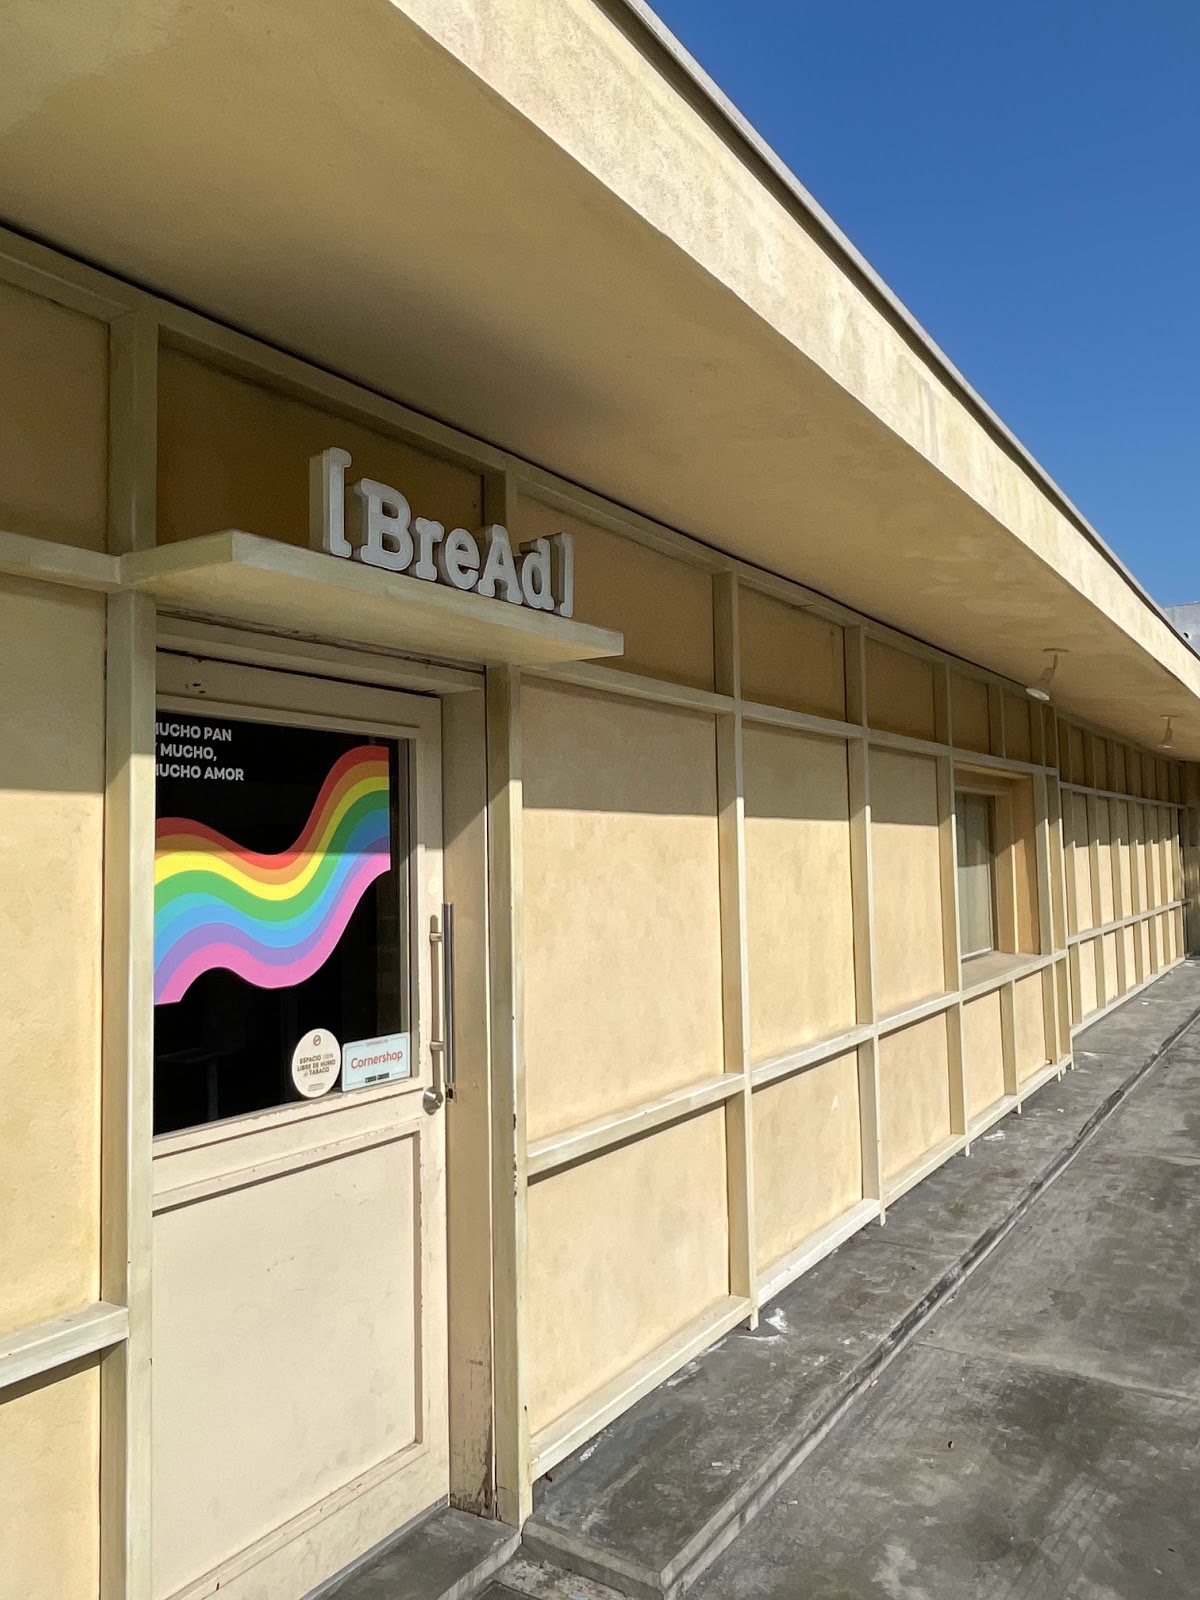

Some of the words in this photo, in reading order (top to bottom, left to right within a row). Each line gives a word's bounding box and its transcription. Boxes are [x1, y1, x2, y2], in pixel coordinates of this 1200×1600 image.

[203, 726, 232, 741] PAN
[160, 743, 217, 762] MUCHO,
[155, 763, 201, 779] UCHO
[203, 766, 244, 781] AMOR
[297, 1063, 311, 1071] LIBRE
[320, 1059, 336, 1067] HUMO
[299, 1055, 321, 1064] ESPACIO
[350, 1050, 403, 1069] Cornershop
[309, 1067, 329, 1075] TABACO
